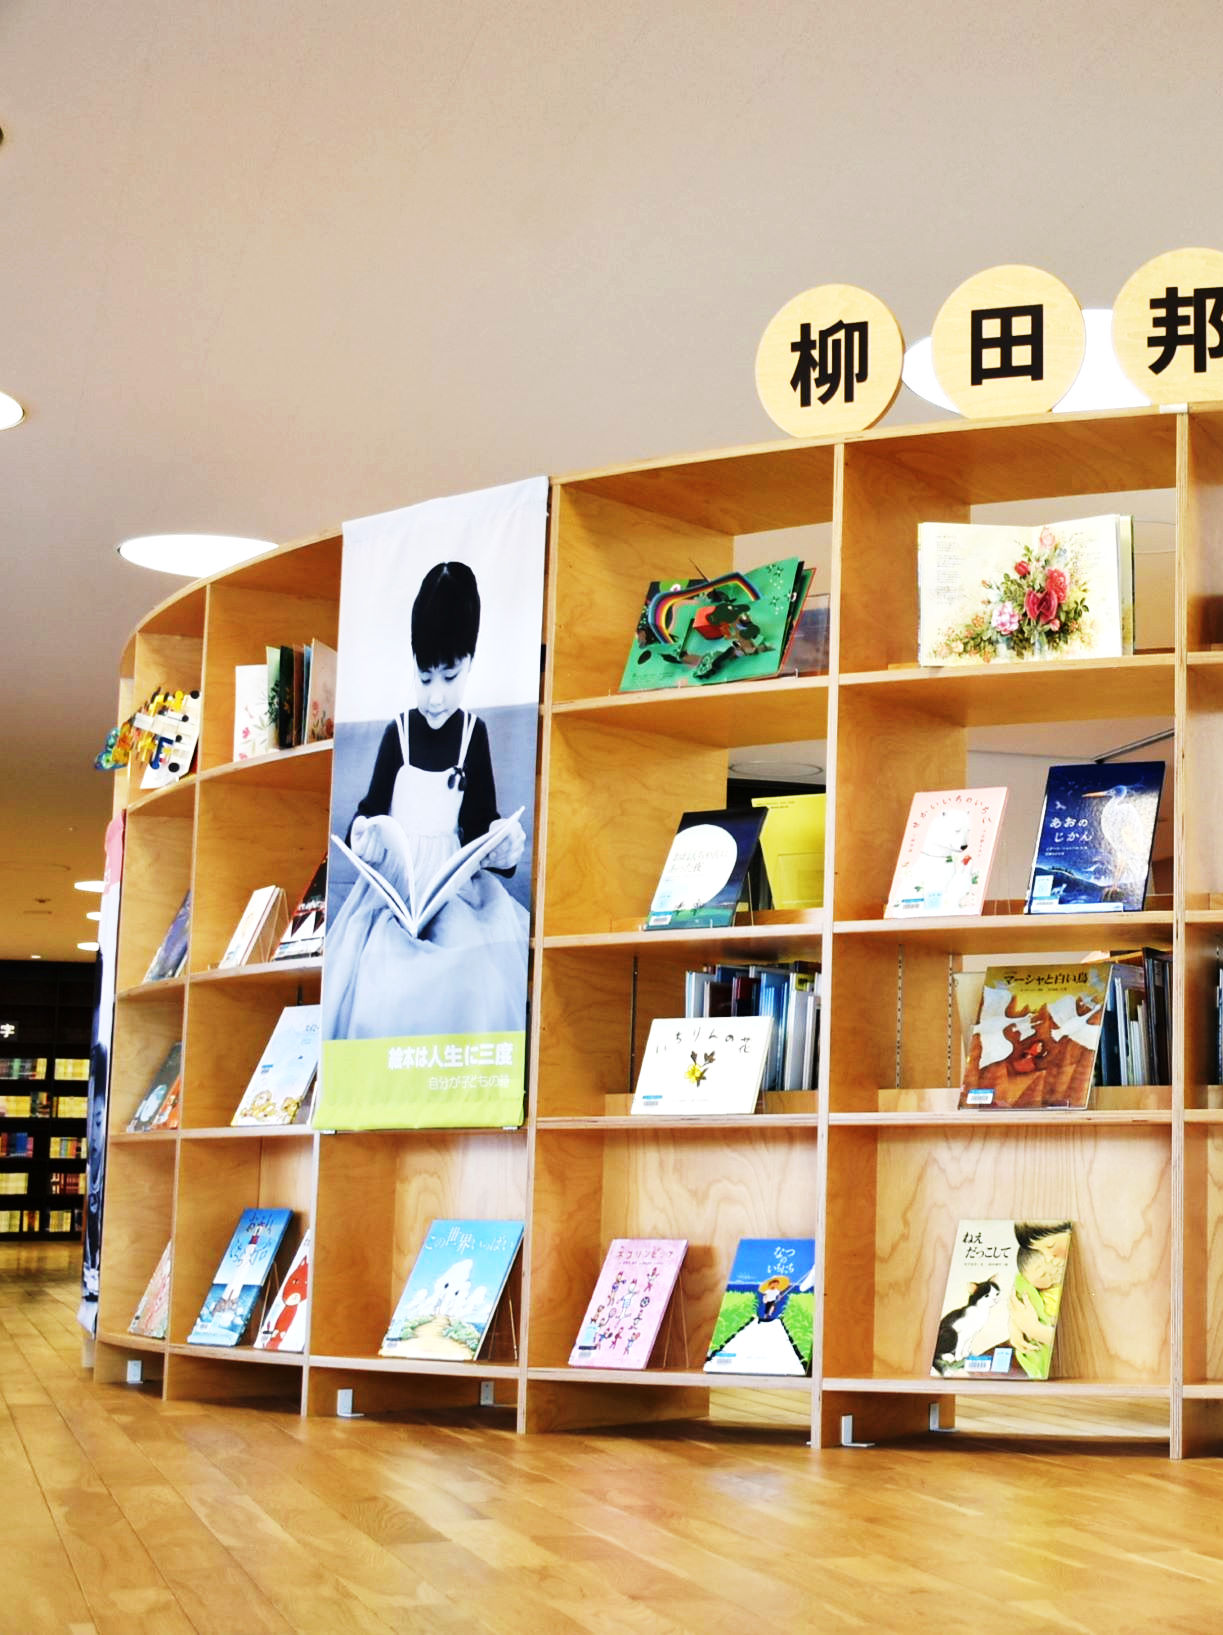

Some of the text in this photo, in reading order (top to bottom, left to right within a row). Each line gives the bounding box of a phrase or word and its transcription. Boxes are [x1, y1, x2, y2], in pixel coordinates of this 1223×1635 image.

[1050, 816, 1089, 829] あおの
[1054, 831, 1093, 843] じかん
[388, 1042, 513, 1070] 絵本は人生に三度
[962, 1231, 983, 1245] ねえ
[965, 1246, 1012, 1259] だっこして
